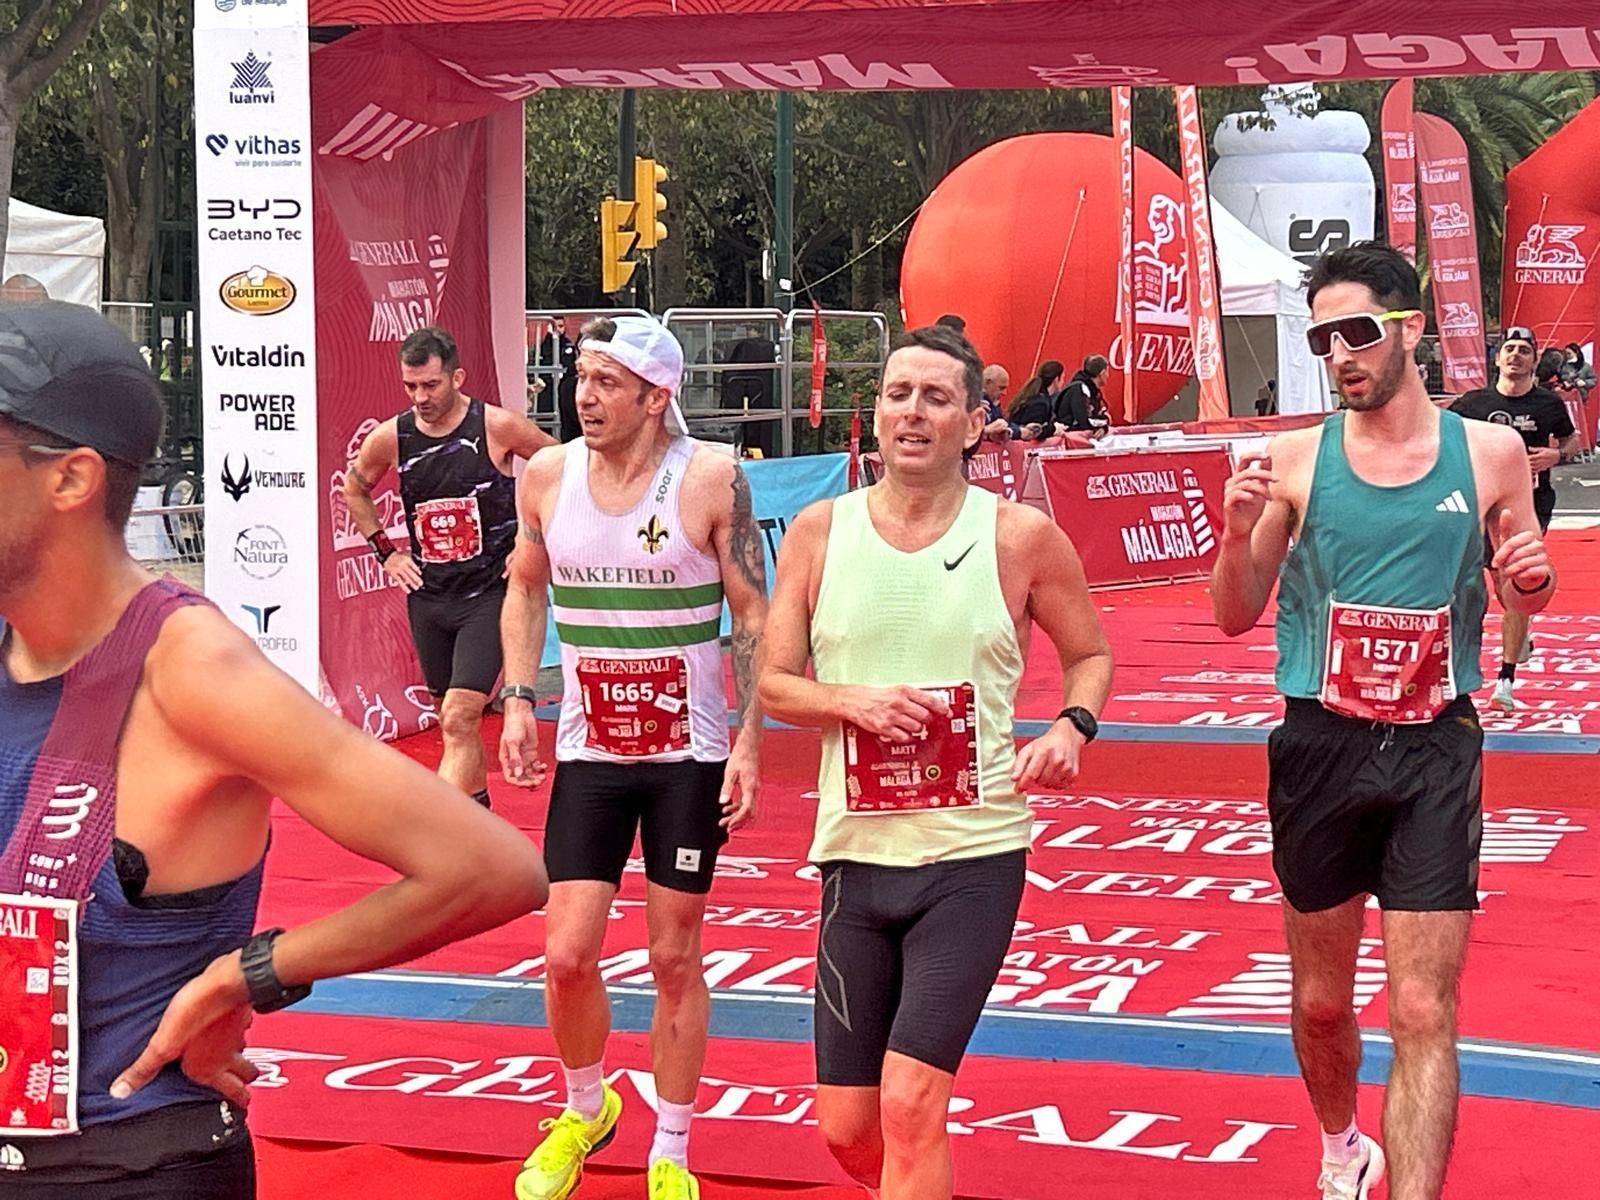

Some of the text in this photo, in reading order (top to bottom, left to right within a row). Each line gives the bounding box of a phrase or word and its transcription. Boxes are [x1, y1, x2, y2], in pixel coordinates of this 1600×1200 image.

[229, 91, 275, 104] luanvi
[235, 135, 301, 155] vithas
[207, 199, 301, 219] BYD
[208, 227, 302, 241] Caetano Tec
[1515, 269, 1585, 285] GENERALI
[227, 285, 289, 298] Gourmet
[211, 344, 305, 367] Vitaldin
[220, 394, 295, 412] POWER
[255, 414, 296, 431] ADE
[254, 470, 306, 489] VENDURE
[656, 468, 673, 504] soar
[1107, 470, 1179, 497] GENERALI
[430, 515, 457, 529] 669
[250, 540, 281, 551] FONT
[1120, 518, 1197, 565] MÁLAGA
[234, 547, 289, 564] Natura
[558, 566, 676, 584] WAKEFIELD
[1359, 636, 1420, 663] 1571
[600, 658, 671, 674] GENERALI
[599, 682, 654, 702] 1665
[52, 940, 70, 987] BOX 2
[51, 1049, 69, 1095] BOX 2
